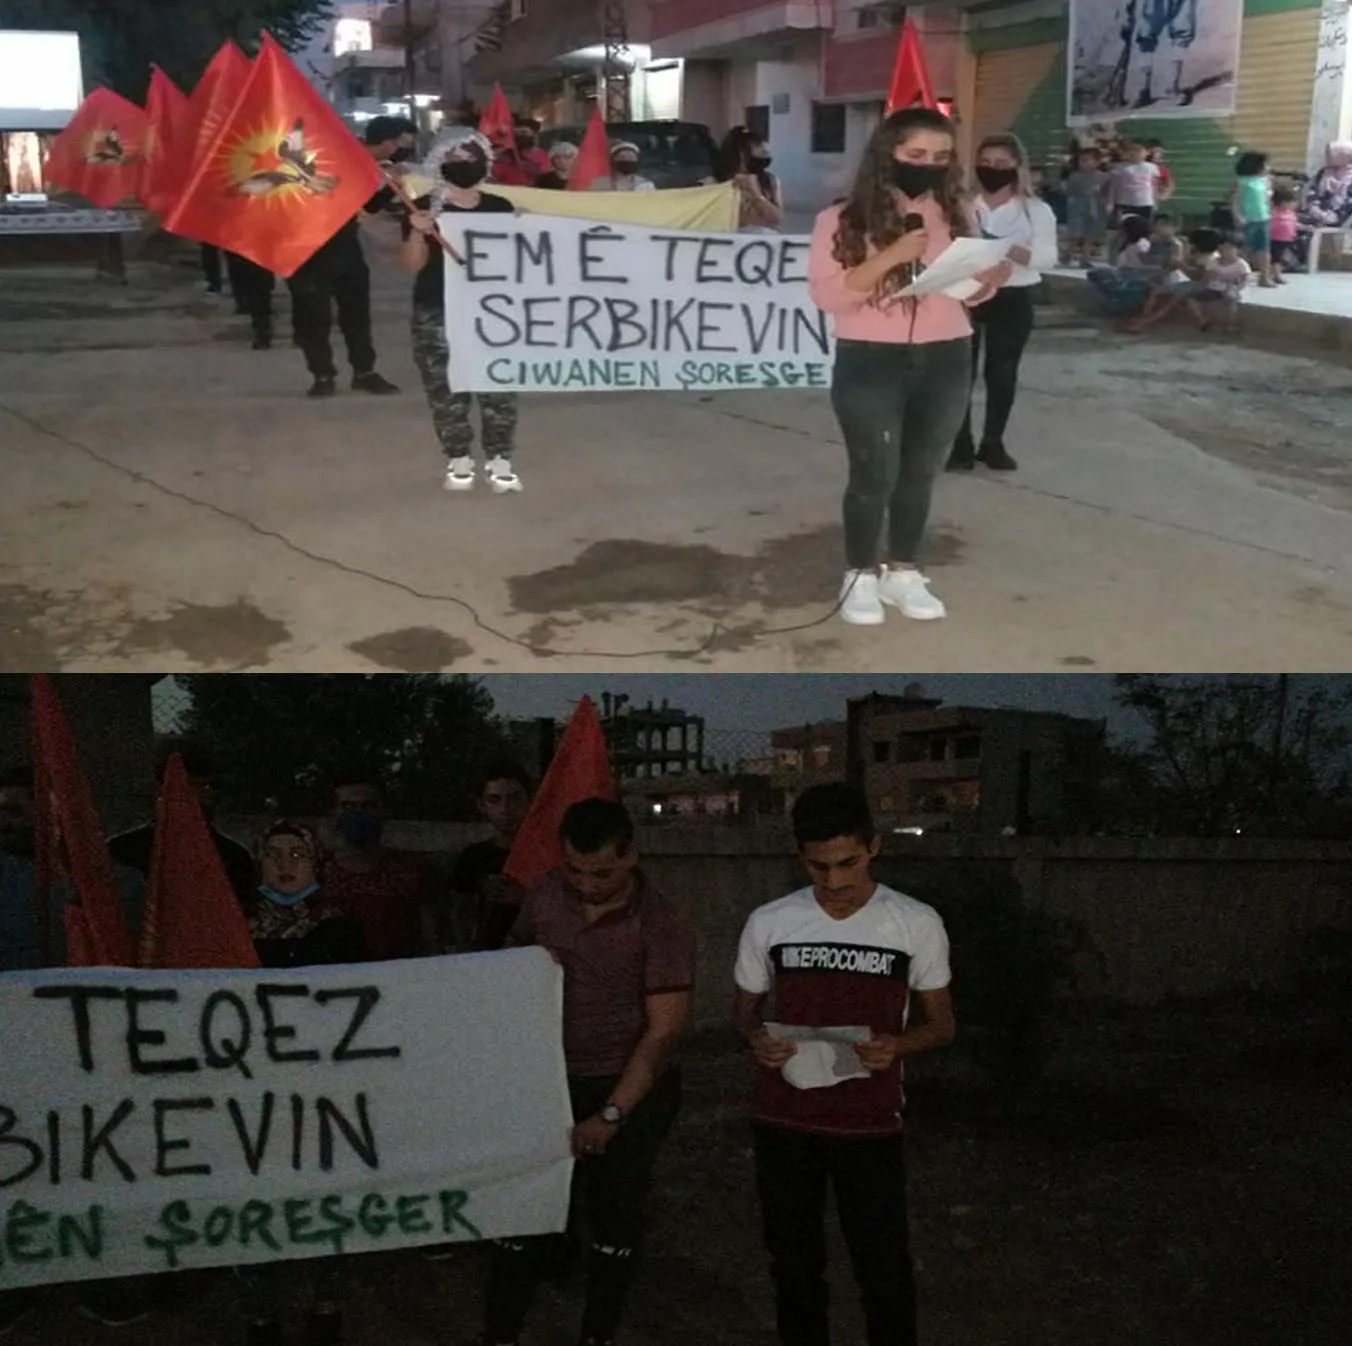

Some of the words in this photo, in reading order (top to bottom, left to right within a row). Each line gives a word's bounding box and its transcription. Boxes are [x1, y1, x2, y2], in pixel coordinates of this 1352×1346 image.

[464, 230, 555, 284] EM
[578, 226, 628, 283] Ê
[650, 235, 812, 287] TEQE
[475, 294, 830, 355] SERBIKEVIN
[487, 358, 661, 387] CIWANEN
[33, 984, 401, 1079] TEQEZ
[0, 1091, 379, 1188] BIKEVIN
[146, 1189, 482, 1268] ŞOREŞGER
